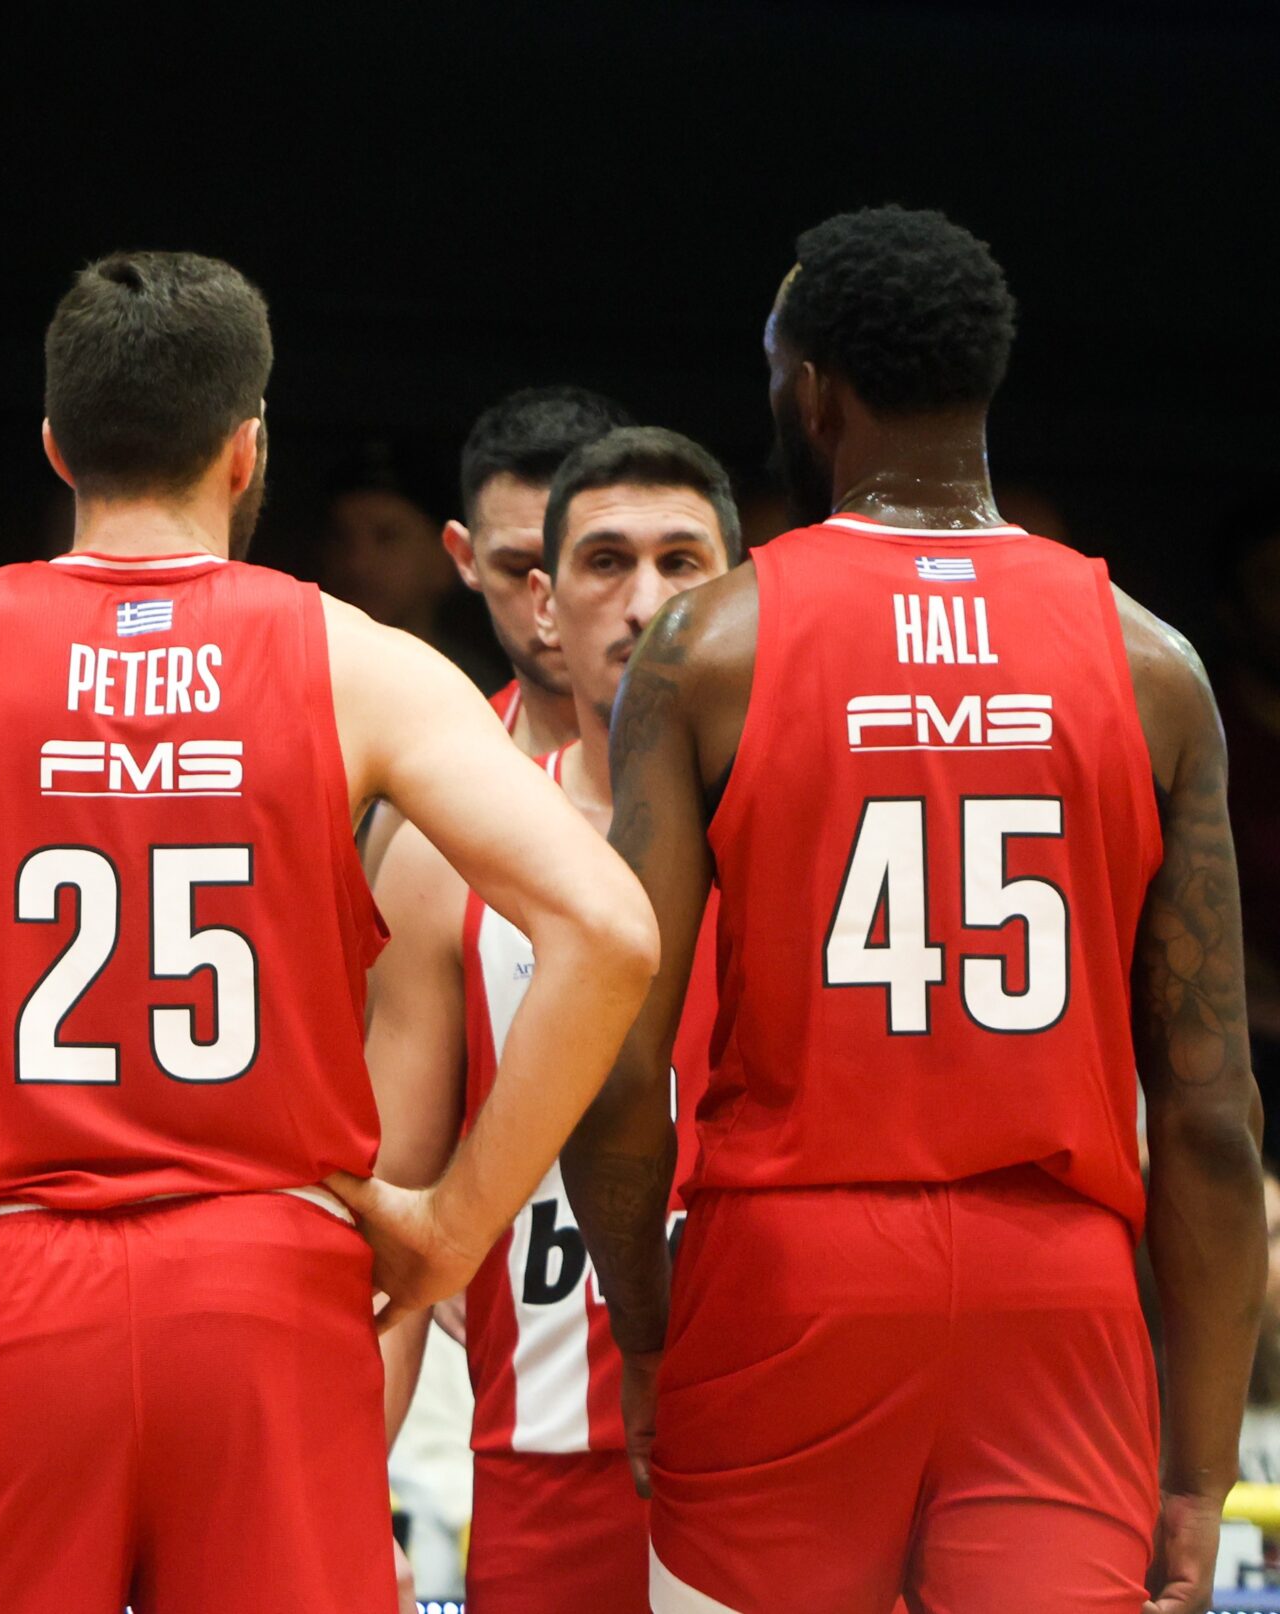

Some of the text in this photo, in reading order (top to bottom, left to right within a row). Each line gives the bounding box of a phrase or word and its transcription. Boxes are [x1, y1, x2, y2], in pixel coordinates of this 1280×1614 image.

[893, 594, 998, 664] HALL
[67, 643, 222, 716] PETERS
[847, 694, 1053, 746] FMS
[40, 740, 243, 791] FMS
[823, 795, 1071, 1036] 45
[14, 844, 260, 1085] 25
